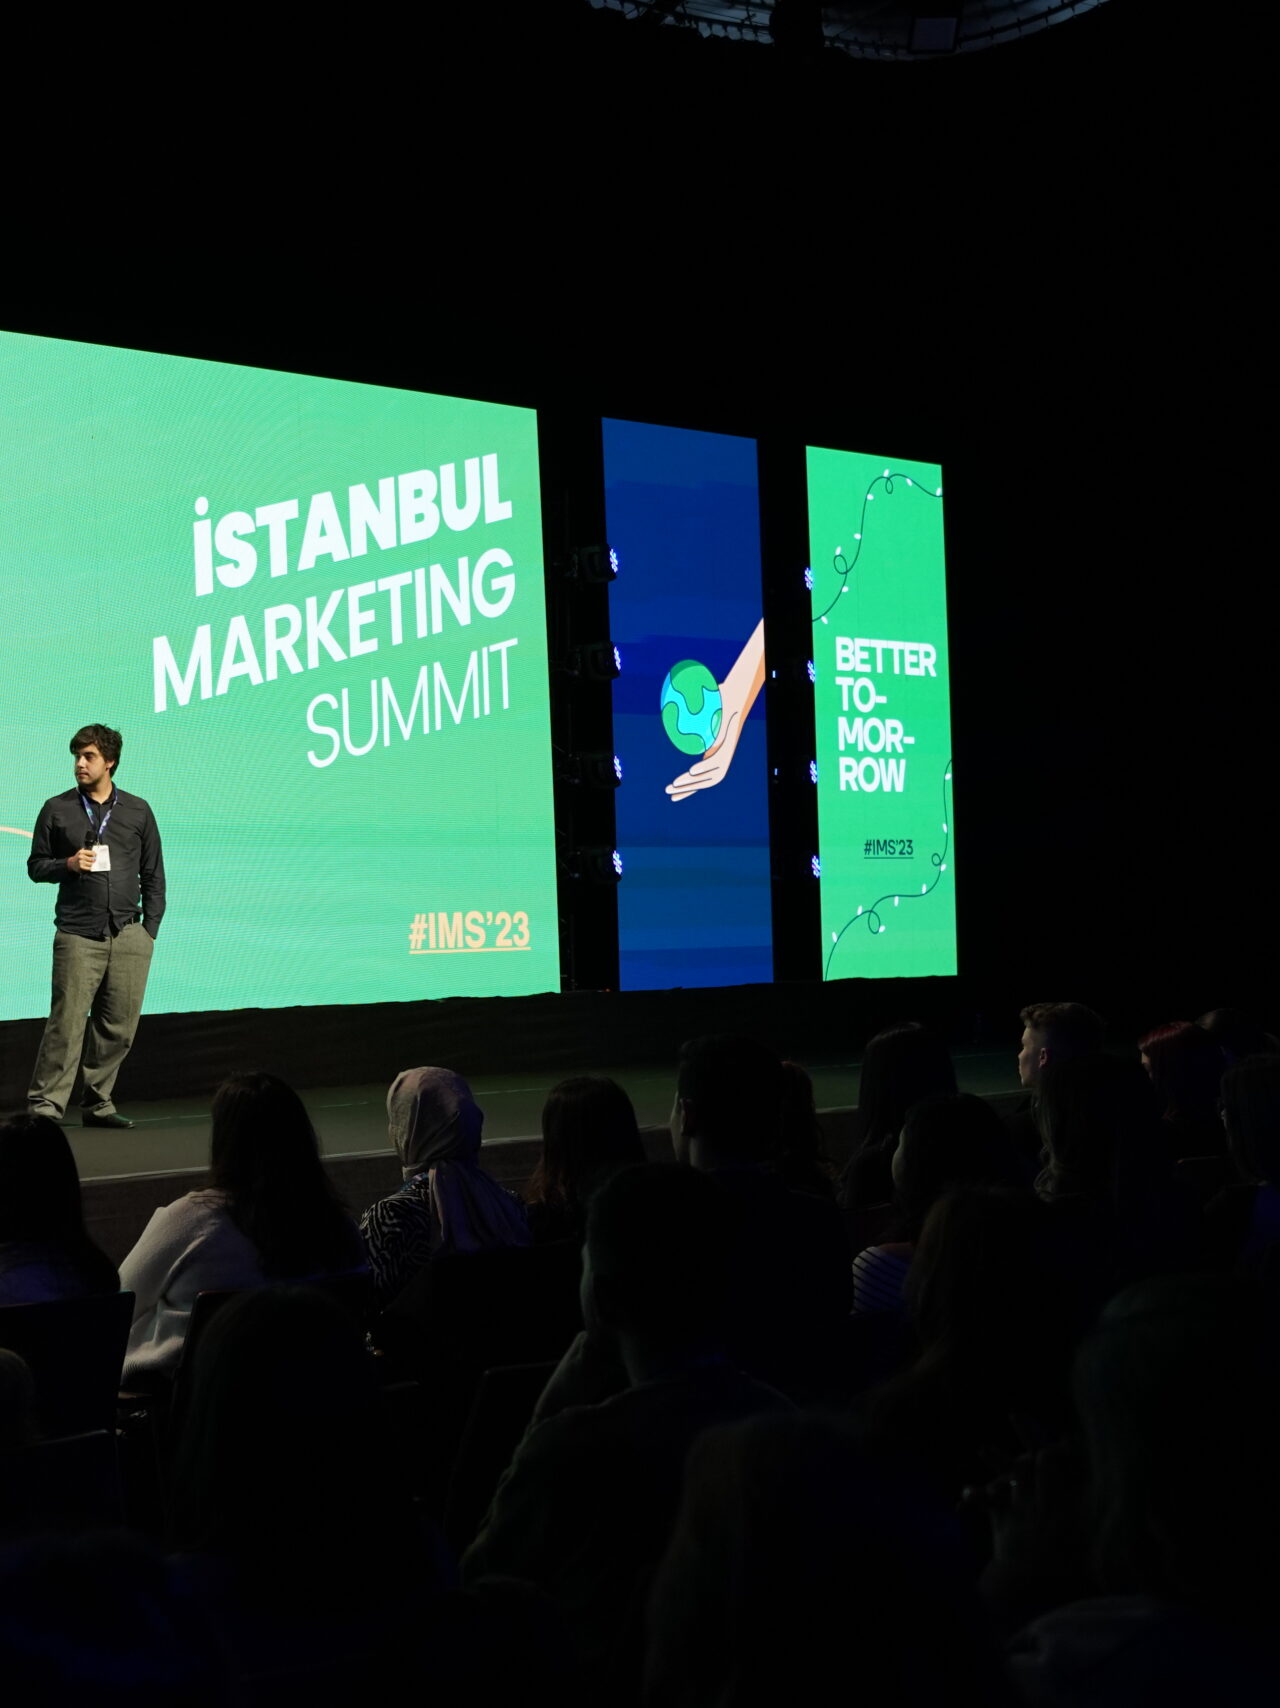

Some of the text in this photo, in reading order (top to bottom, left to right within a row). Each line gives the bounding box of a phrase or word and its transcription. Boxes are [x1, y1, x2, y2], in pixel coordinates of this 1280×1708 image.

[152, 548, 516, 714] MARKETING
[835, 636, 937, 677] BETTER
[306, 638, 519, 769] SUMMIT
[835, 676, 888, 713] TO-
[837, 716, 915, 753] MOR-
[838, 756, 906, 793] ROW
